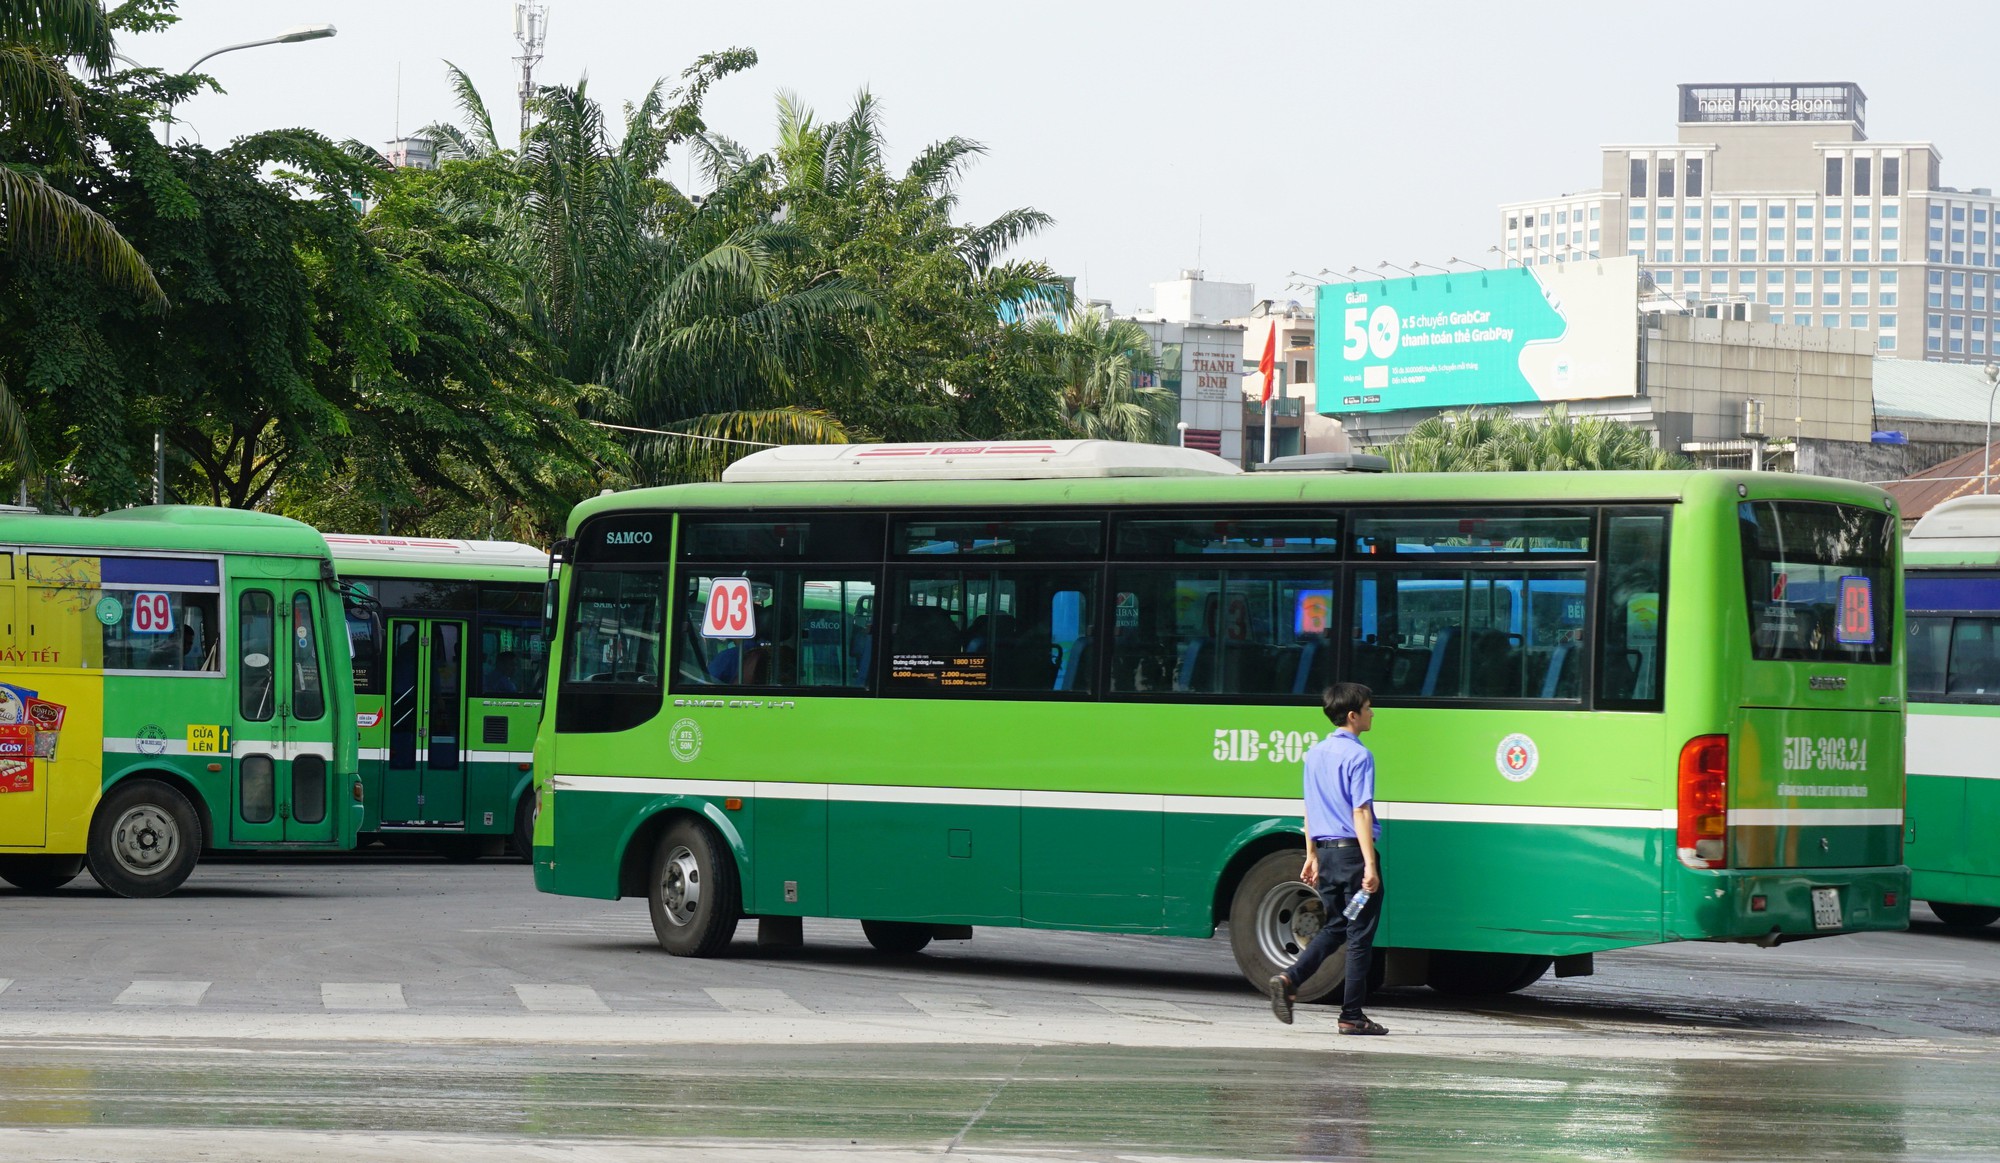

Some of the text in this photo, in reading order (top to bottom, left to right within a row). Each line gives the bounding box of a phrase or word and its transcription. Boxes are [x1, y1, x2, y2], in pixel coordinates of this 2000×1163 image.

[1699, 97, 1832, 113] hotel nikko saigon
[1402, 310, 1491, 329] x 5 chuyến GrabCar
[1402, 331, 1429, 347] thanh
[1431, 331, 1453, 345] toán
[1472, 327, 1514, 343] GrabPay
[1193, 359, 1234, 372] THANH
[1198, 372, 1227, 388] BÌNH
[606, 531, 653, 544] SAMCO
[136, 594, 169, 631] 69
[711, 585, 748, 631] 03
[1846, 587, 1869, 634] 03
[810, 620, 840, 629] SAMCO
[31, 646, 60, 662] TẾT
[674, 699, 725, 707] SAMCO
[729, 700, 763, 708] CITY
[193, 727, 214, 739] CỬA
[0, 743, 23, 752] COSY
[193, 741, 213, 752] LÊN
[1213, 729, 1334, 763] 51B-303
[1783, 736, 1867, 771] 51B-303.24
